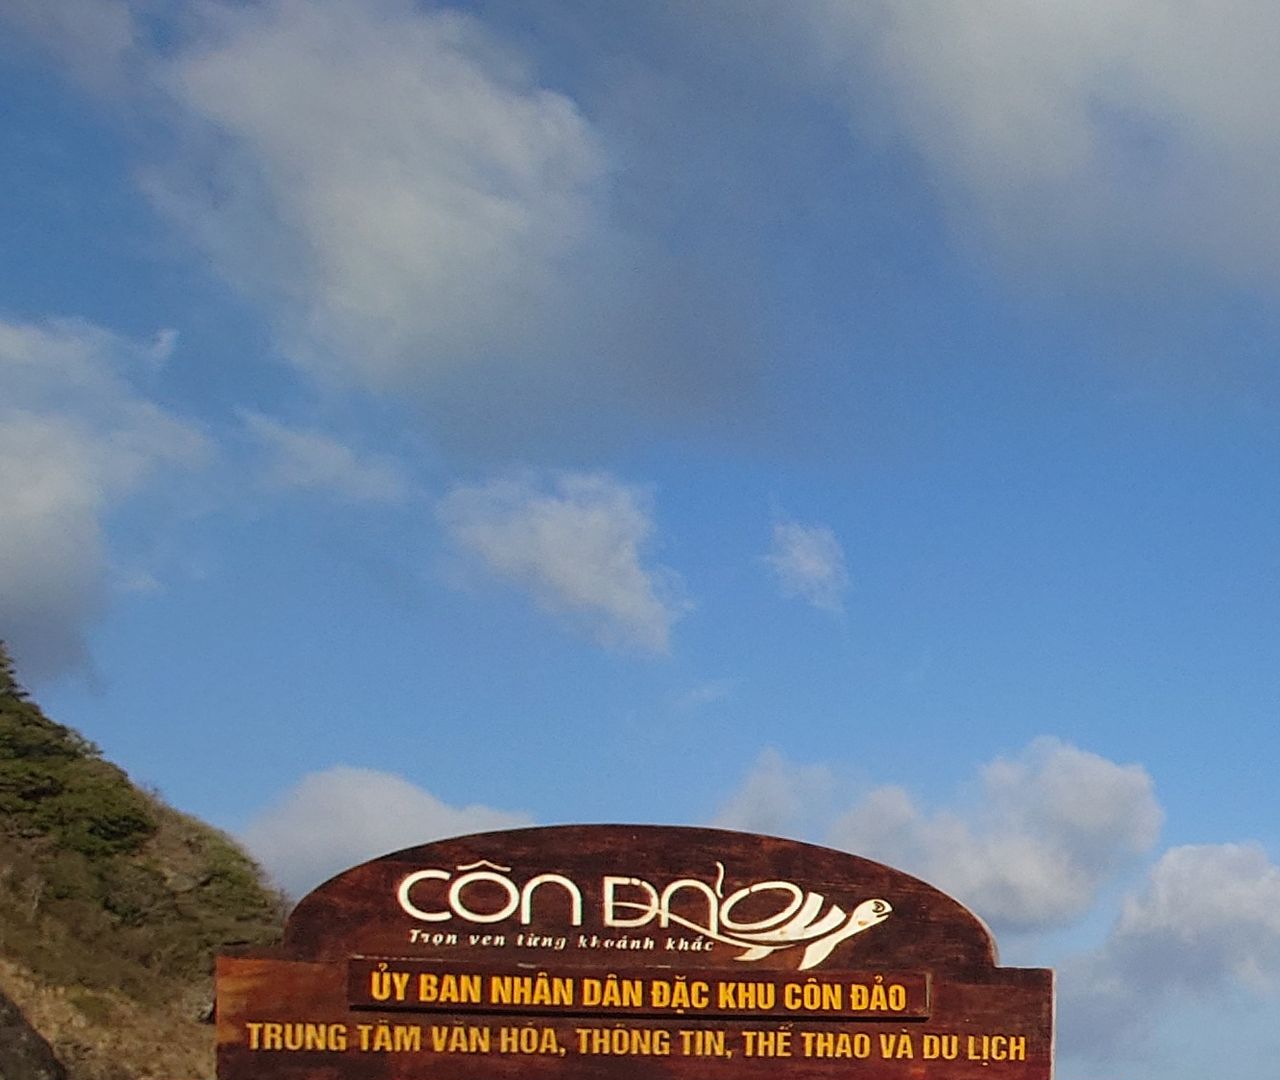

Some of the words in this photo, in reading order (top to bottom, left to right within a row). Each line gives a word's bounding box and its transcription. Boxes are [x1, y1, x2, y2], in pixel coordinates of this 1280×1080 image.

[398, 860, 582, 926] CÔN
[371, 962, 410, 1001] ỦY
[419, 973, 482, 1003] BAN
[490, 971, 574, 1006] NHÂN
[582, 973, 643, 1007] DÂN
[651, 975, 709, 1014] ĐẶC
[718, 981, 775, 1010] KHU
[784, 977, 842, 1011] CÔN
[850, 975, 906, 1012] ĐẢO
[246, 1022, 348, 1052] TRUNG
[500, 1021, 567, 1057] HÓA,
[679, 1029, 734, 1060] TIN,
[801, 1031, 871, 1059] THAO
[879, 1027, 914, 1059] VÀ
[922, 1034, 959, 1061] DU
[967, 1034, 1026, 1066] LỊCH
